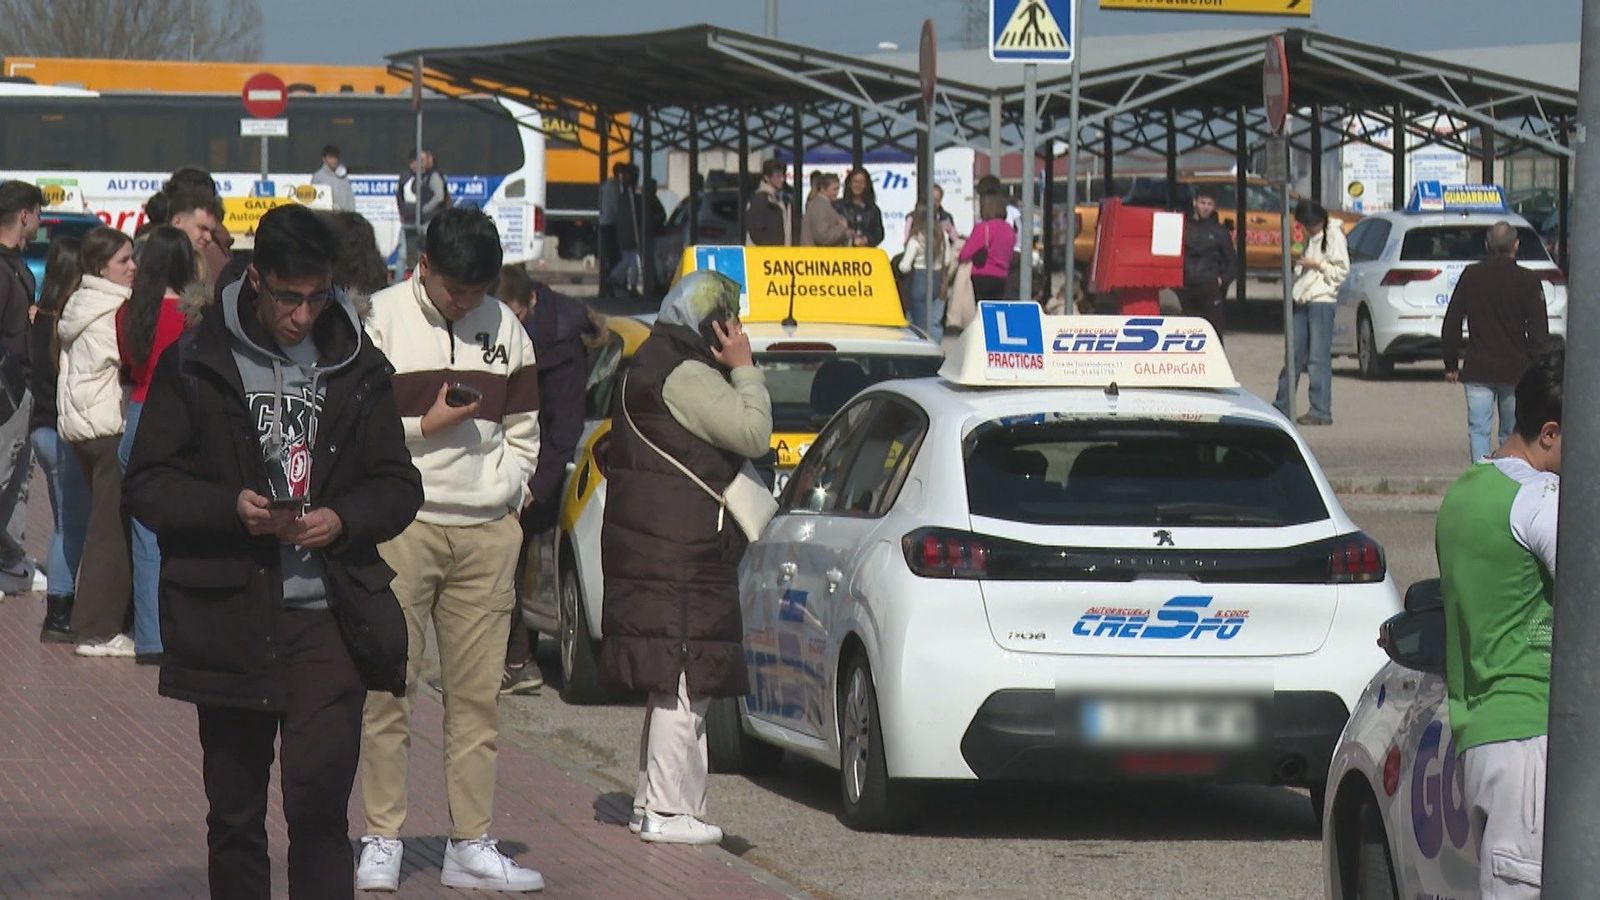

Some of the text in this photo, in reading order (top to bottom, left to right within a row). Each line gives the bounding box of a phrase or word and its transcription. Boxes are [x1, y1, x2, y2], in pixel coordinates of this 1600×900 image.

[1443, 191, 1502, 204] GUADARRAMA
[763, 259, 873, 277] SANCHINARRO
[766, 279, 873, 297] Autoescuela
[995, 310, 1028, 346] L
[988, 353, 1044, 370] PRACTICAS
[1134, 362, 1206, 375] GALAPAGAR
